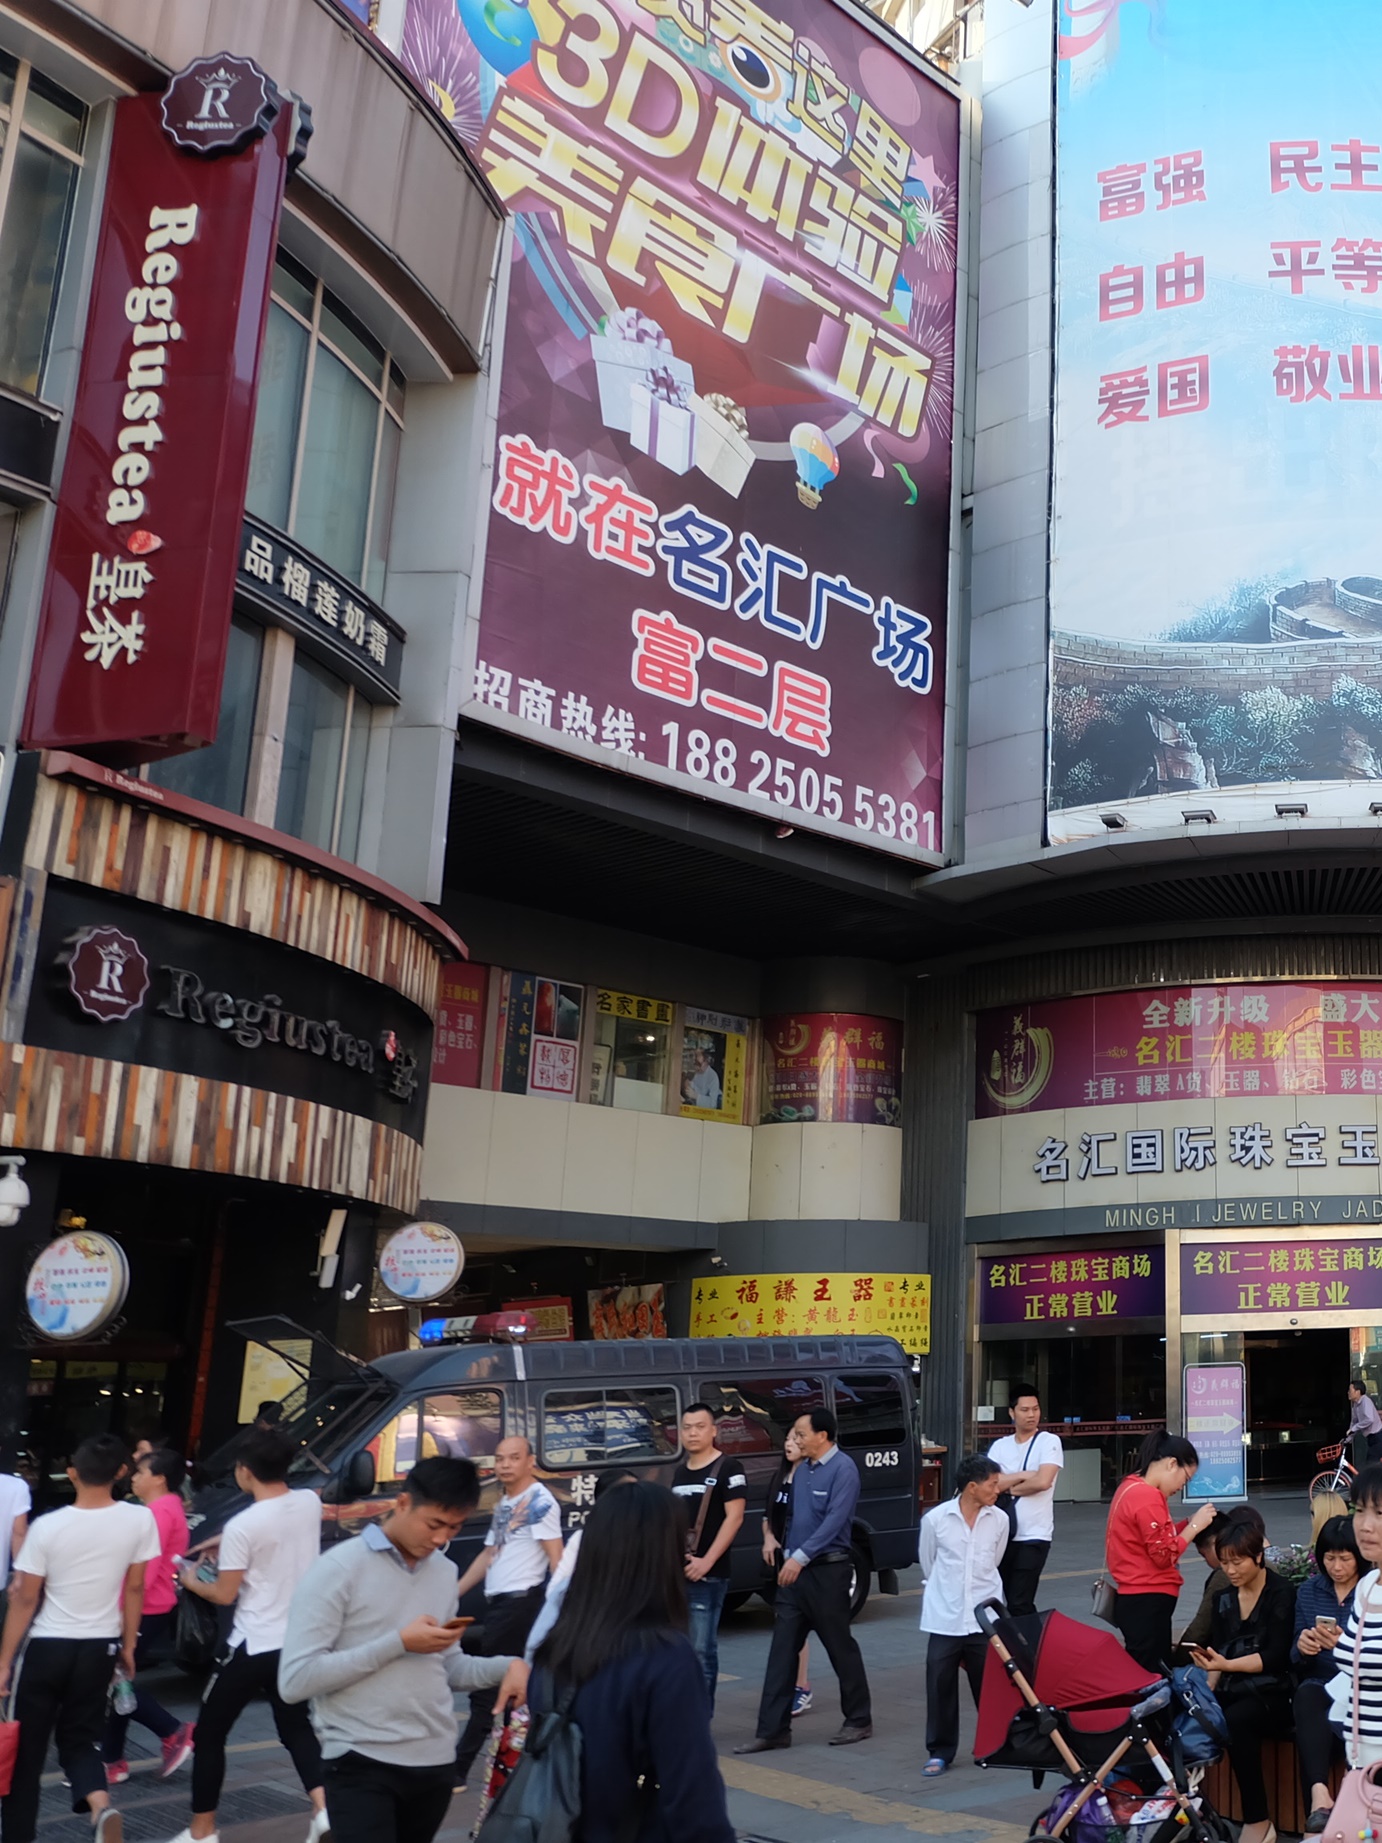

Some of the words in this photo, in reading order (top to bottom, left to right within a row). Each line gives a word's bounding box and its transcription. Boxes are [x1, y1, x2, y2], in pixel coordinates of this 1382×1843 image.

[1097, 149, 1207, 222] 富强
[1098, 252, 1206, 322] 自由
[106, 203, 200, 526] Regiustea
[1097, 354, 1210, 429] 爱国
[244, 534, 389, 667] 品榴莲奶霜
[493, 434, 933, 695] 就在名汇广场
[80, 551, 156, 670] 皇茶
[631, 607, 832, 758] 富二层
[661, 719, 738, 788] 188
[748, 749, 844, 822] 2505
[854, 784, 936, 851] 5381
[1142, 994, 1270, 1029] 全新升级
[1211, 1200, 1322, 1223] JEWELRY
[988, 1253, 1151, 1288] 名汇二楼珠宝商场
[1024, 1290, 1118, 1320] 正常营业
[1236, 1280, 1351, 1310] 正常营业
[865, 1450, 899, 1468] 0243
